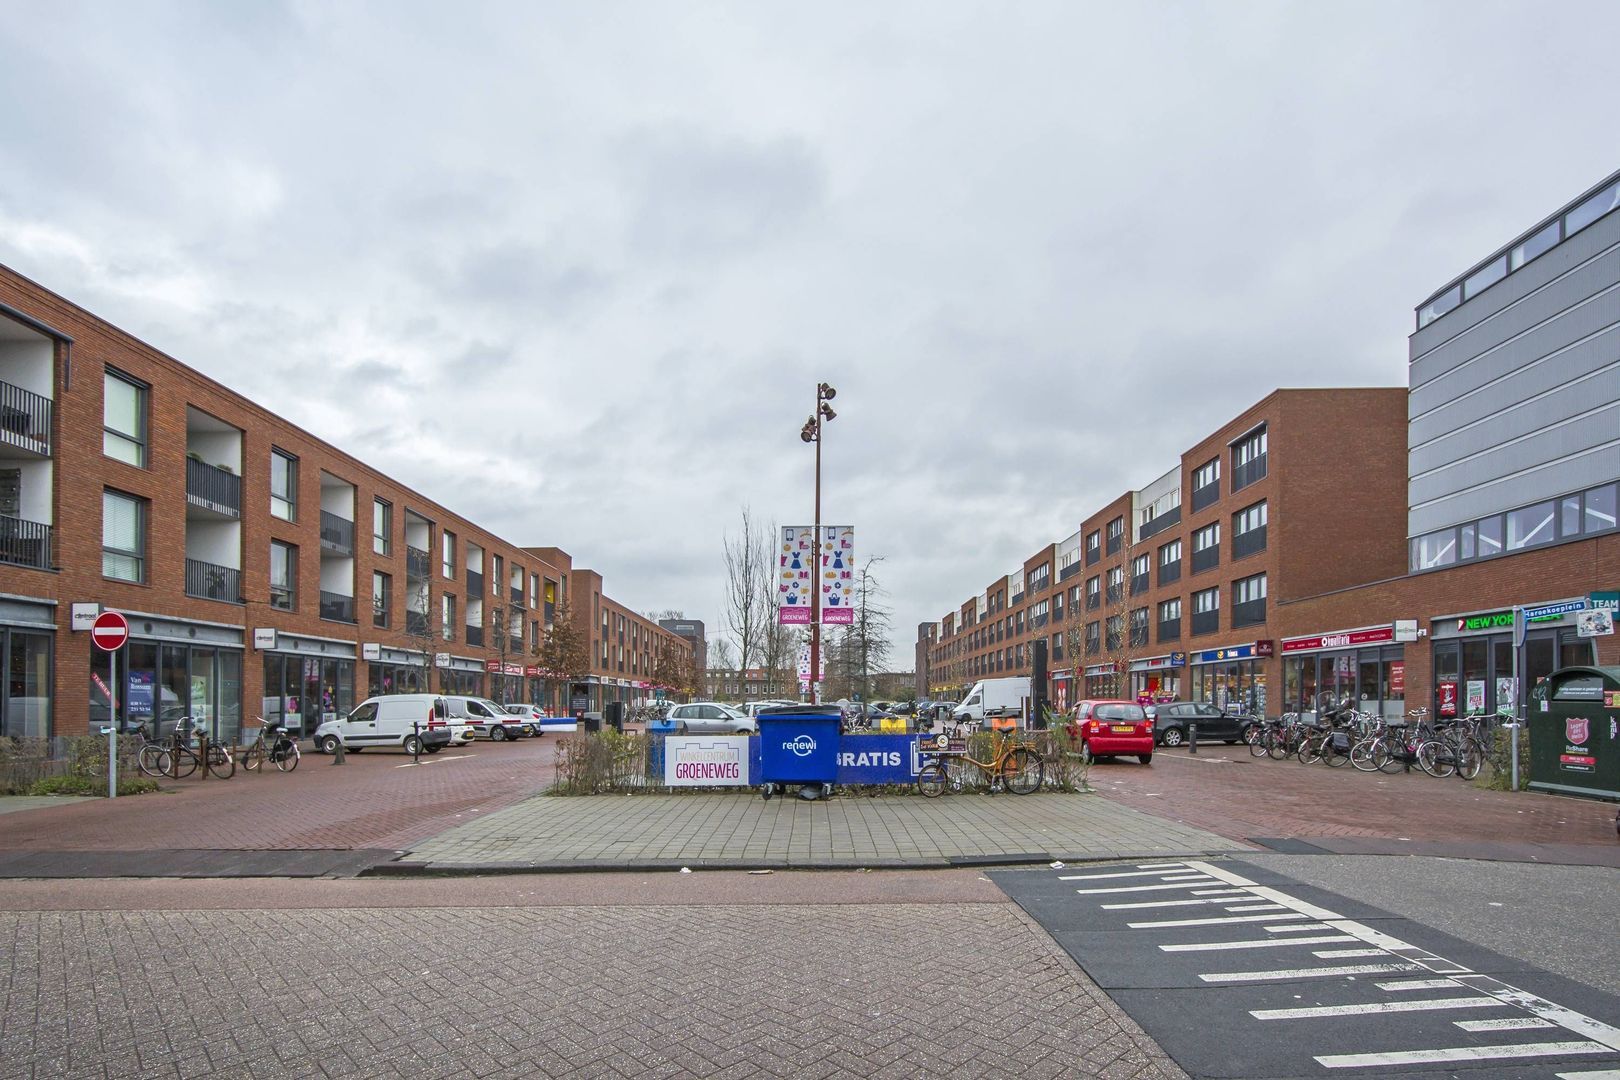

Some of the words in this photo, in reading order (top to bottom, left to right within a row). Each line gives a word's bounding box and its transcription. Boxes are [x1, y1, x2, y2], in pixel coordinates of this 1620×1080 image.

[1592, 600, 1618, 609] TEAM
[1467, 617, 1490, 629] NEW
[1492, 613, 1514, 626] YOR
[783, 739, 817, 750] renewi
[680, 752, 735, 761] WINKELCENTRUM
[676, 762, 739, 779] GROENEWEG
